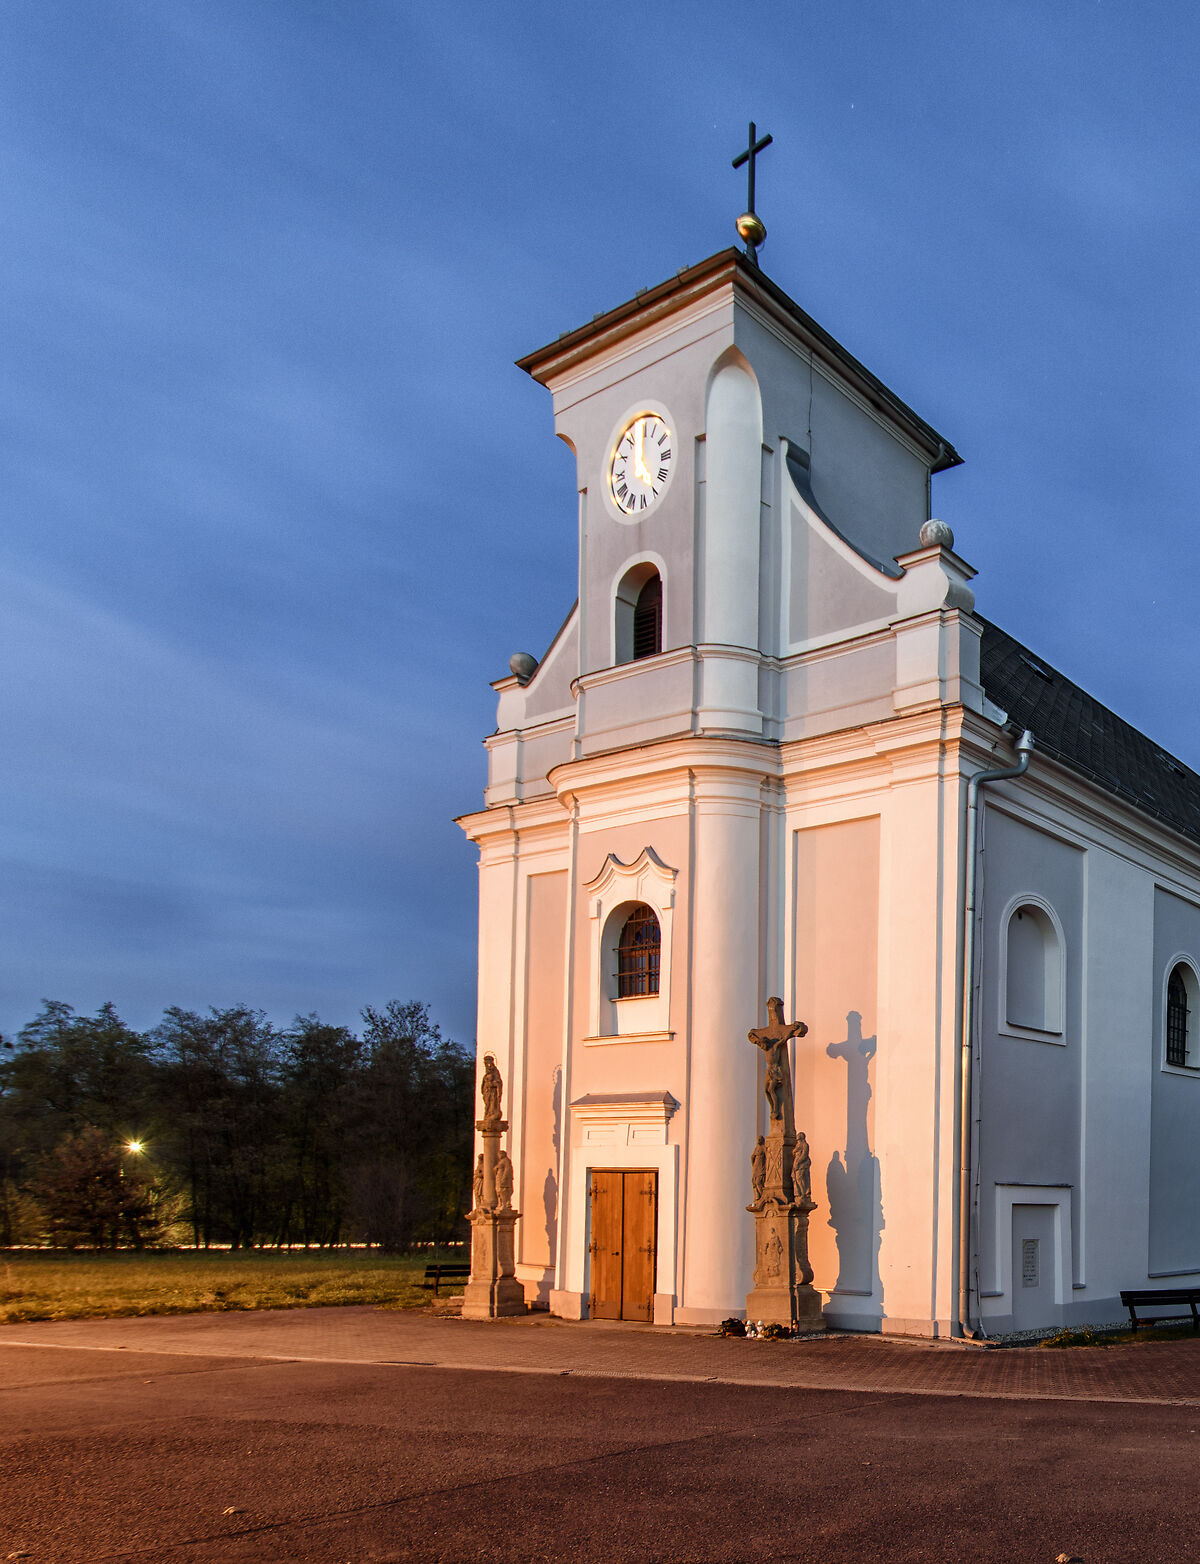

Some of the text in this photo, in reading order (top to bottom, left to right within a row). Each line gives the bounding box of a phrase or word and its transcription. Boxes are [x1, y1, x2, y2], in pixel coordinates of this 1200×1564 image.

[661, 449, 671, 461] III
[657, 468, 669, 482] IIII
[652, 486, 659, 499] V
